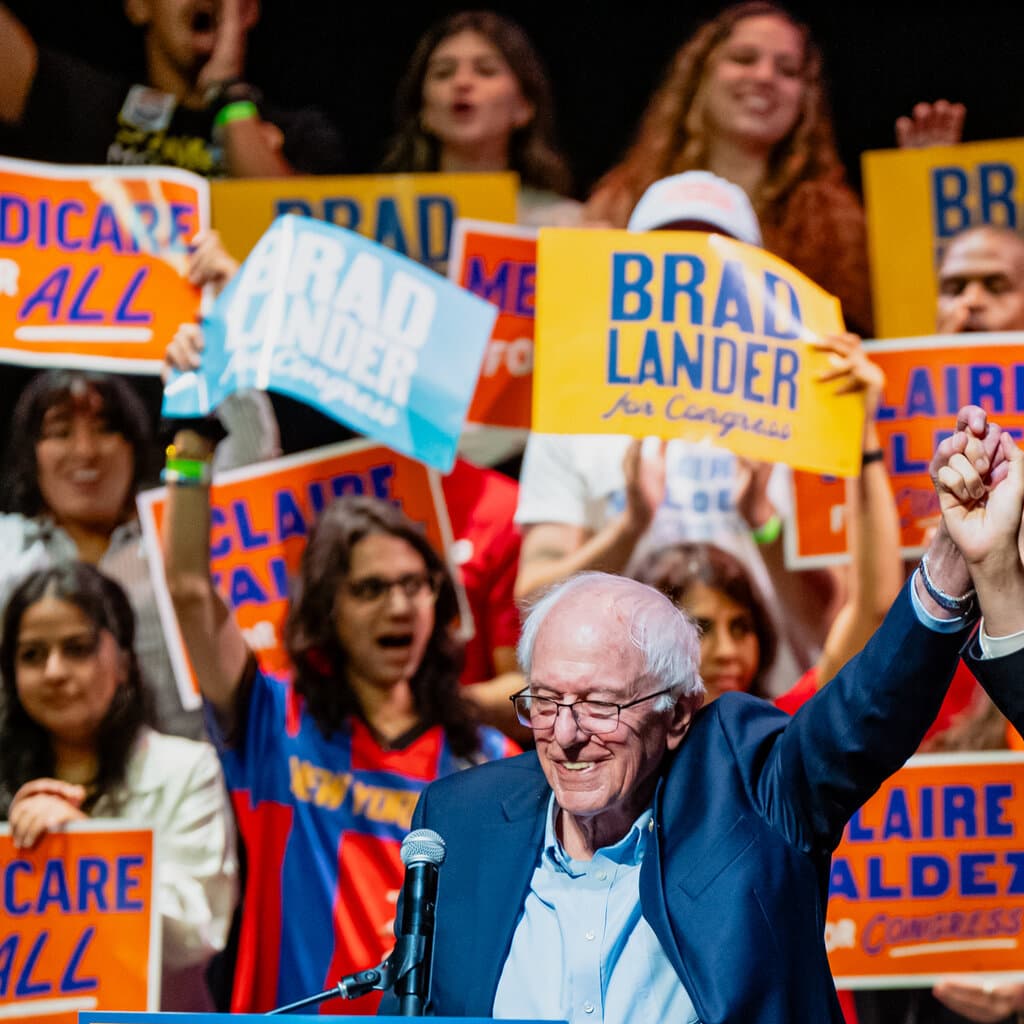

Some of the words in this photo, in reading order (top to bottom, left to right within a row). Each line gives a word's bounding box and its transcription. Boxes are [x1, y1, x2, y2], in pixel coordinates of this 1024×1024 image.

[0, 195, 197, 253] DICARE
[19, 265, 151, 320] ALL
[610, 252, 802, 340] BRAD
[606, 328, 800, 410] LANDER
[602, 391, 655, 419] for
[665, 393, 792, 438] Congress
[848, 784, 1014, 841] LAIRE
[3, 856, 144, 915] CARE
